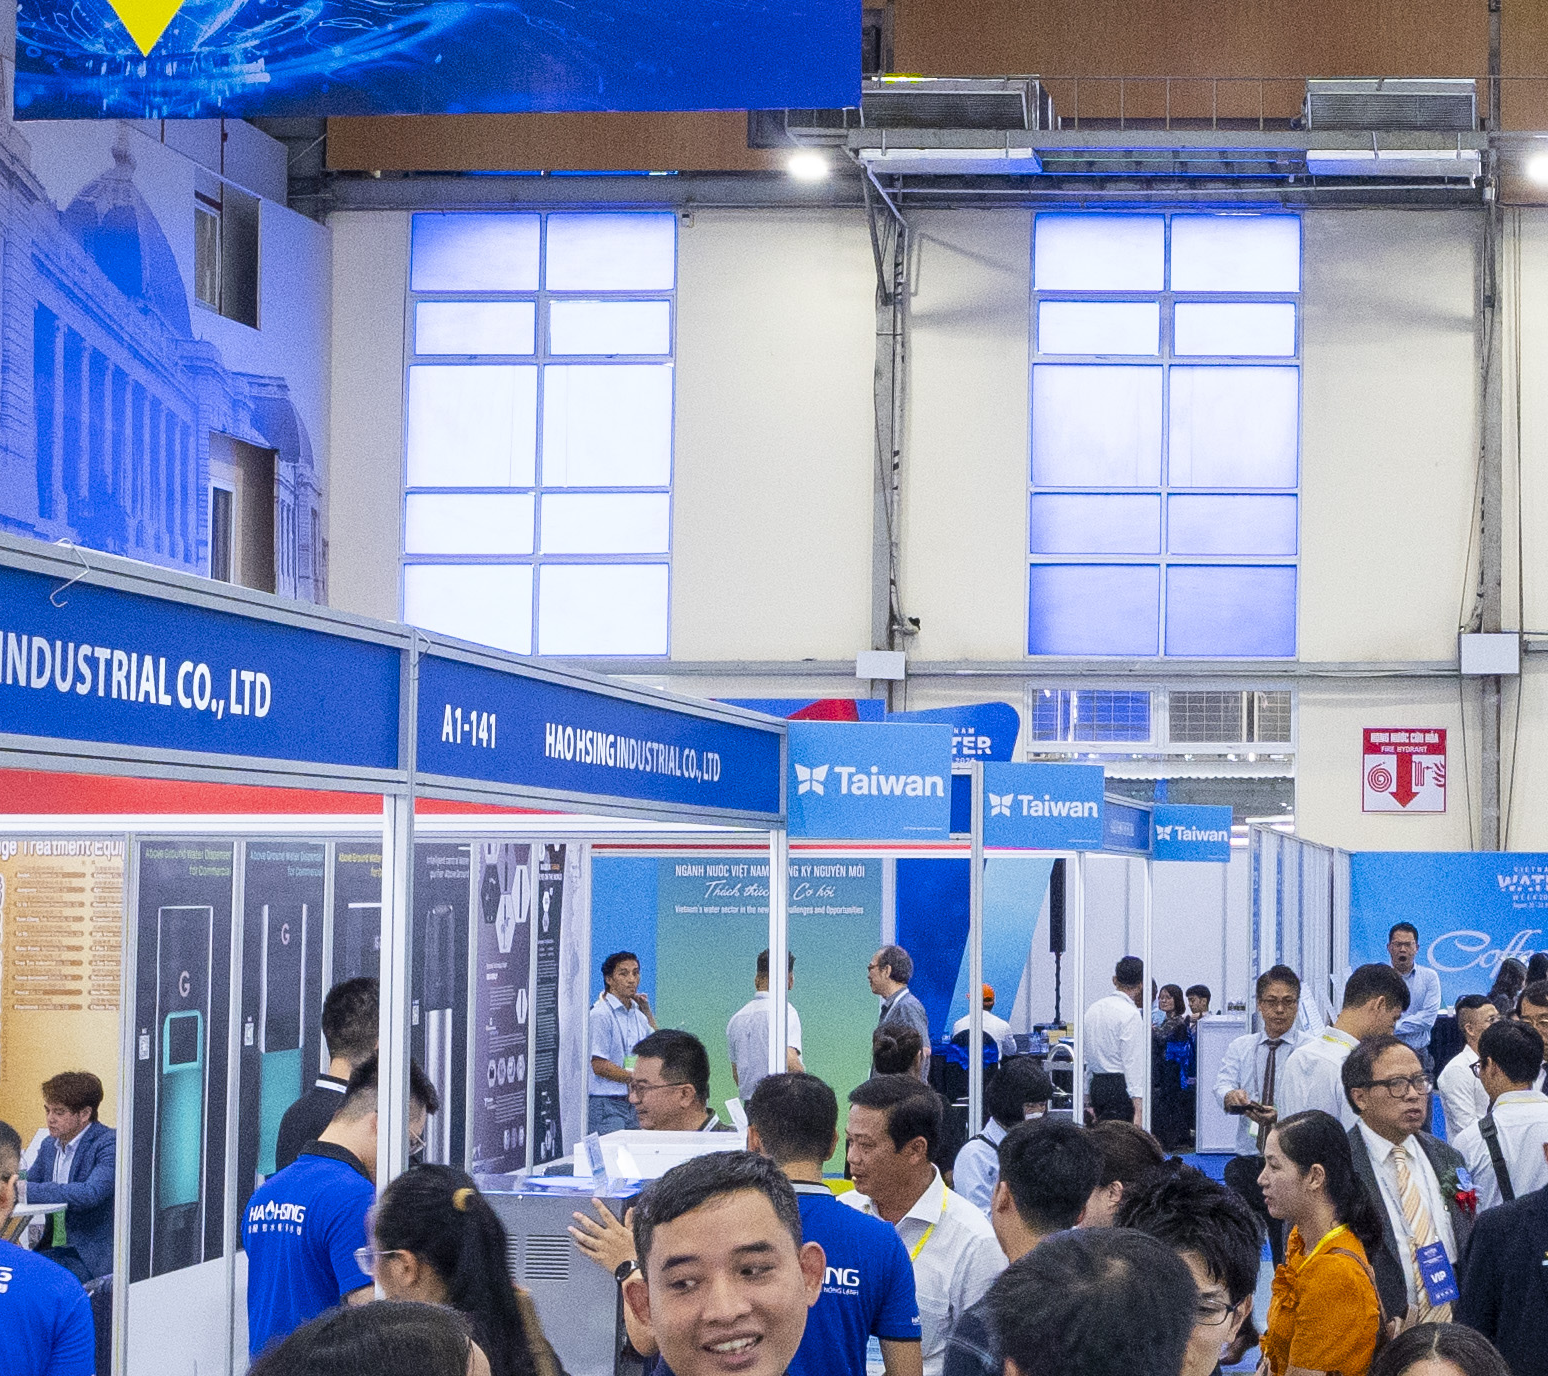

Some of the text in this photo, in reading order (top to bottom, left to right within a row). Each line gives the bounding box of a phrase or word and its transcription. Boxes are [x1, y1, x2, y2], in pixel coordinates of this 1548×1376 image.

[177, 660, 225, 719] CO.,
[230, 670, 272, 718] LTD
[442, 703, 496, 748] A1-141
[546, 722, 721, 782] HAO HSING INDUSTRIAL CO., LTD
[834, 765, 944, 797] Taiwan
[1018, 793, 1098, 818] Taiwan
[1174, 826, 1228, 842] Taiwan
[676, 863, 704, 877] NGÀNH
[732, 863, 750, 879] VIỆT
[752, 865, 769, 877] NAM
[814, 863, 846, 877] NGUYÊN
[1430, 1270, 1447, 1284] VIP
